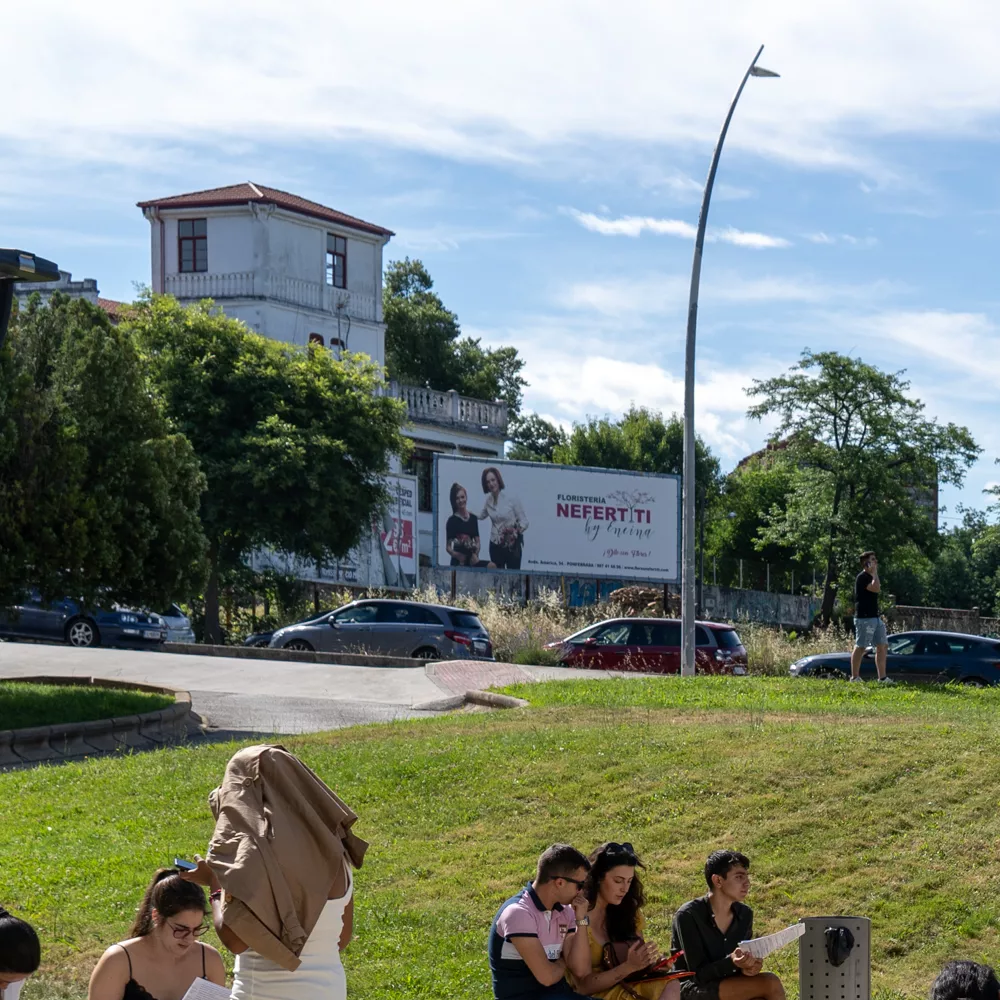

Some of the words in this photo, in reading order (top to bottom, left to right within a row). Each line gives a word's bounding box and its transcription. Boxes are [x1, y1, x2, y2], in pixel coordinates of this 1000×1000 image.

[557, 494, 606, 504] FLORISTERÍA
[556, 503, 651, 524] NEFERTITI
[584, 516, 600, 542] by
[607, 520, 655, 540] Encina
